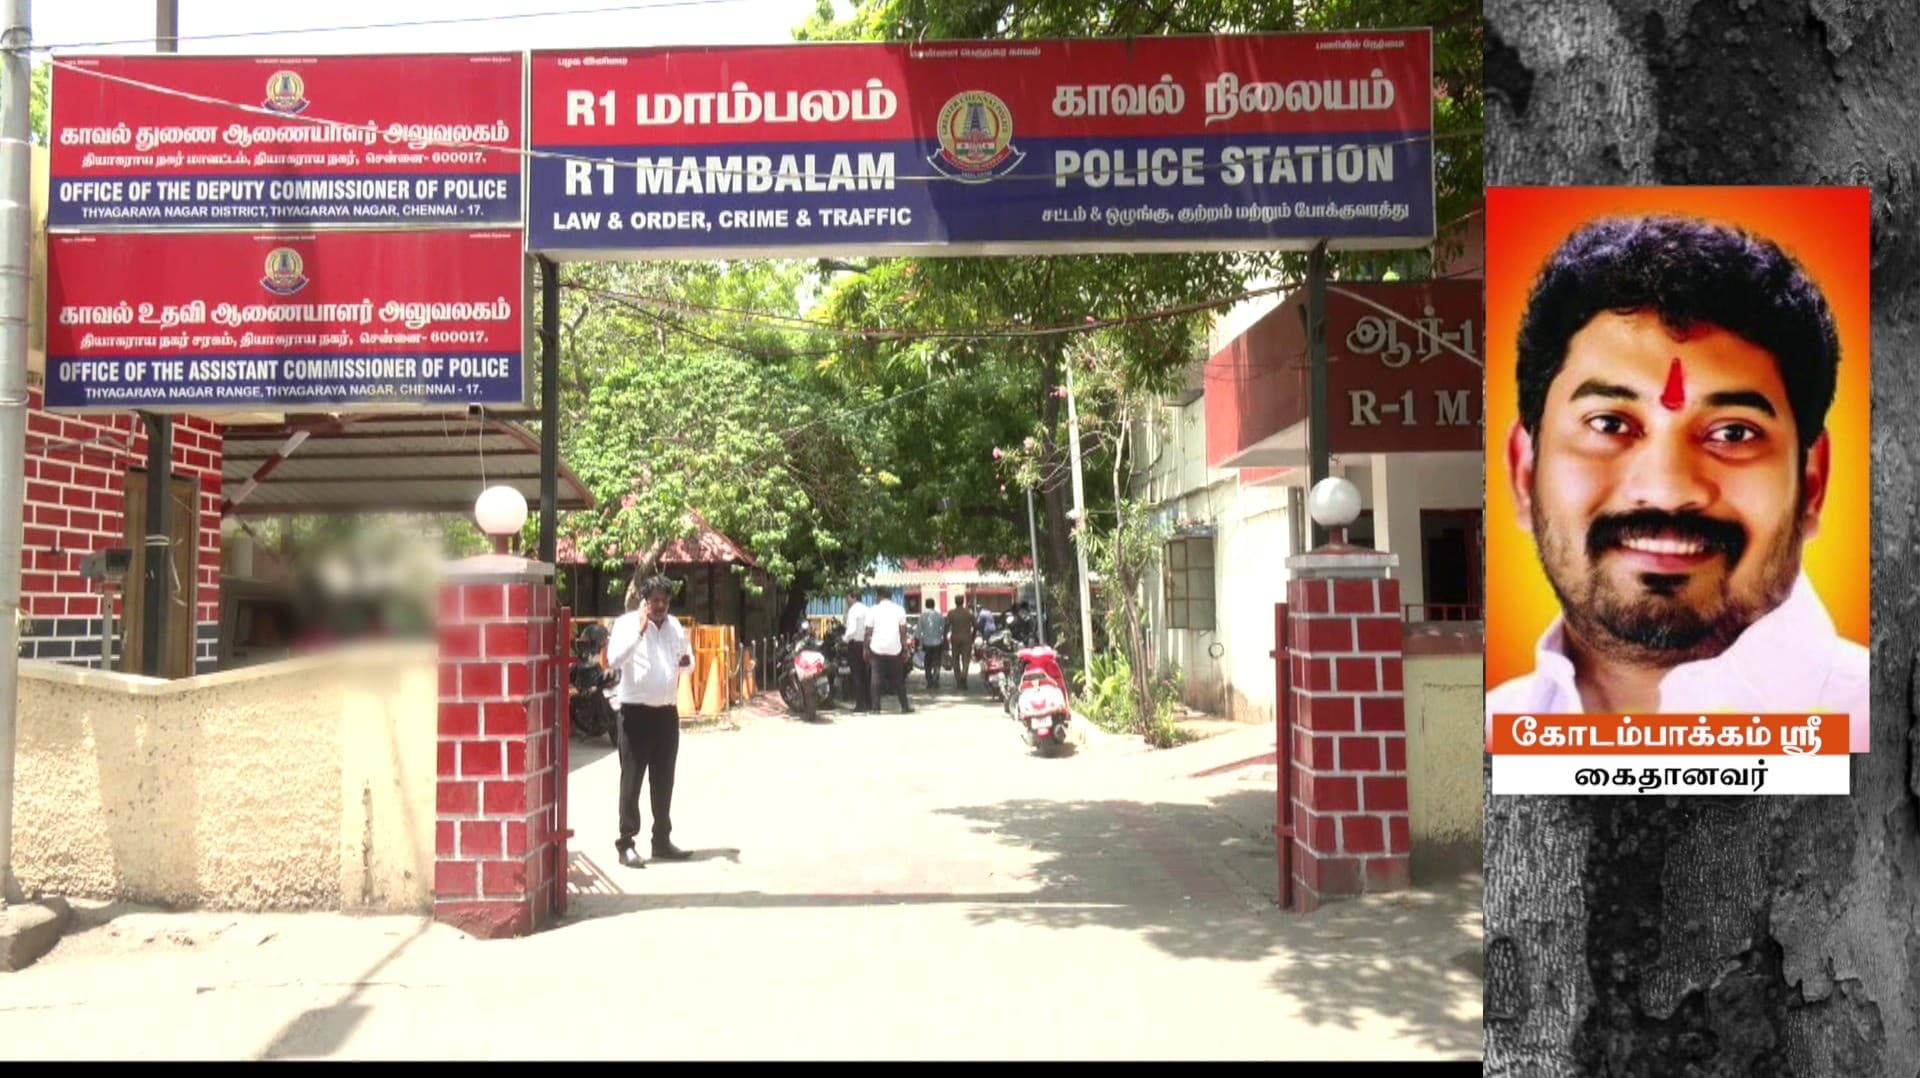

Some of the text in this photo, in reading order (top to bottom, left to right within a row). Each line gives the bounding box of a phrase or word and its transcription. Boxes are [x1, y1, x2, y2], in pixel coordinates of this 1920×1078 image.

[566, 78, 898, 126] R1 மாம்பலம்
[1051, 68, 1395, 127] காவல் நிலையம்
[59, 120, 510, 151] காவல் துணை ஆணையாளர் அலுவலகம்
[155, 150, 184, 168] நகர்
[432, 152, 487, 164] 600017.
[1055, 147, 1205, 188] POLICE
[1220, 143, 1394, 186] STATION
[565, 156, 616, 196] R1
[636, 152, 897, 195] MAMBALAM
[59, 179, 507, 202] OFFICE OF THE DEPUTY COMMISSIONER OF POLICE
[82, 206, 162, 219] THYAGARAYA
[164, 206, 209, 218] NAGAR
[210, 206, 269, 218] DISTRICT,
[270, 205, 351, 217] THYAGARAYA
[352, 204, 400, 217] NAGAR,
[402, 204, 458, 216] CHENNAI
[467, 204, 485, 216] 17.
[553, 207, 912, 232] LAW & ORDER, CRIME & TRAFFIC
[1041, 205, 1087, 222] சட்டம்
[1089, 206, 1102, 222] &
[1177, 203, 1233, 223] குற்றம்
[1235, 201, 1292, 224] மற்றும்
[1294, 200, 1409, 223] போக்குவரத்து
[59, 296, 512, 330] காவல் உதவி ஆணையாளர் அலுவலகம்
[159, 331, 190, 350] நகர்
[430, 330, 489, 343] 600017.
[59, 357, 509, 382] OFFICE OF THE ASSISTANT COMMISSIONER OF POLICE
[85, 387, 167, 399] THYAGARAYA
[168, 386, 214, 399] NAGAR
[265, 384, 347, 397] THYAGARAYA
[399, 383, 456, 396] CHENNAI
[1348, 389, 1417, 427] R-1
